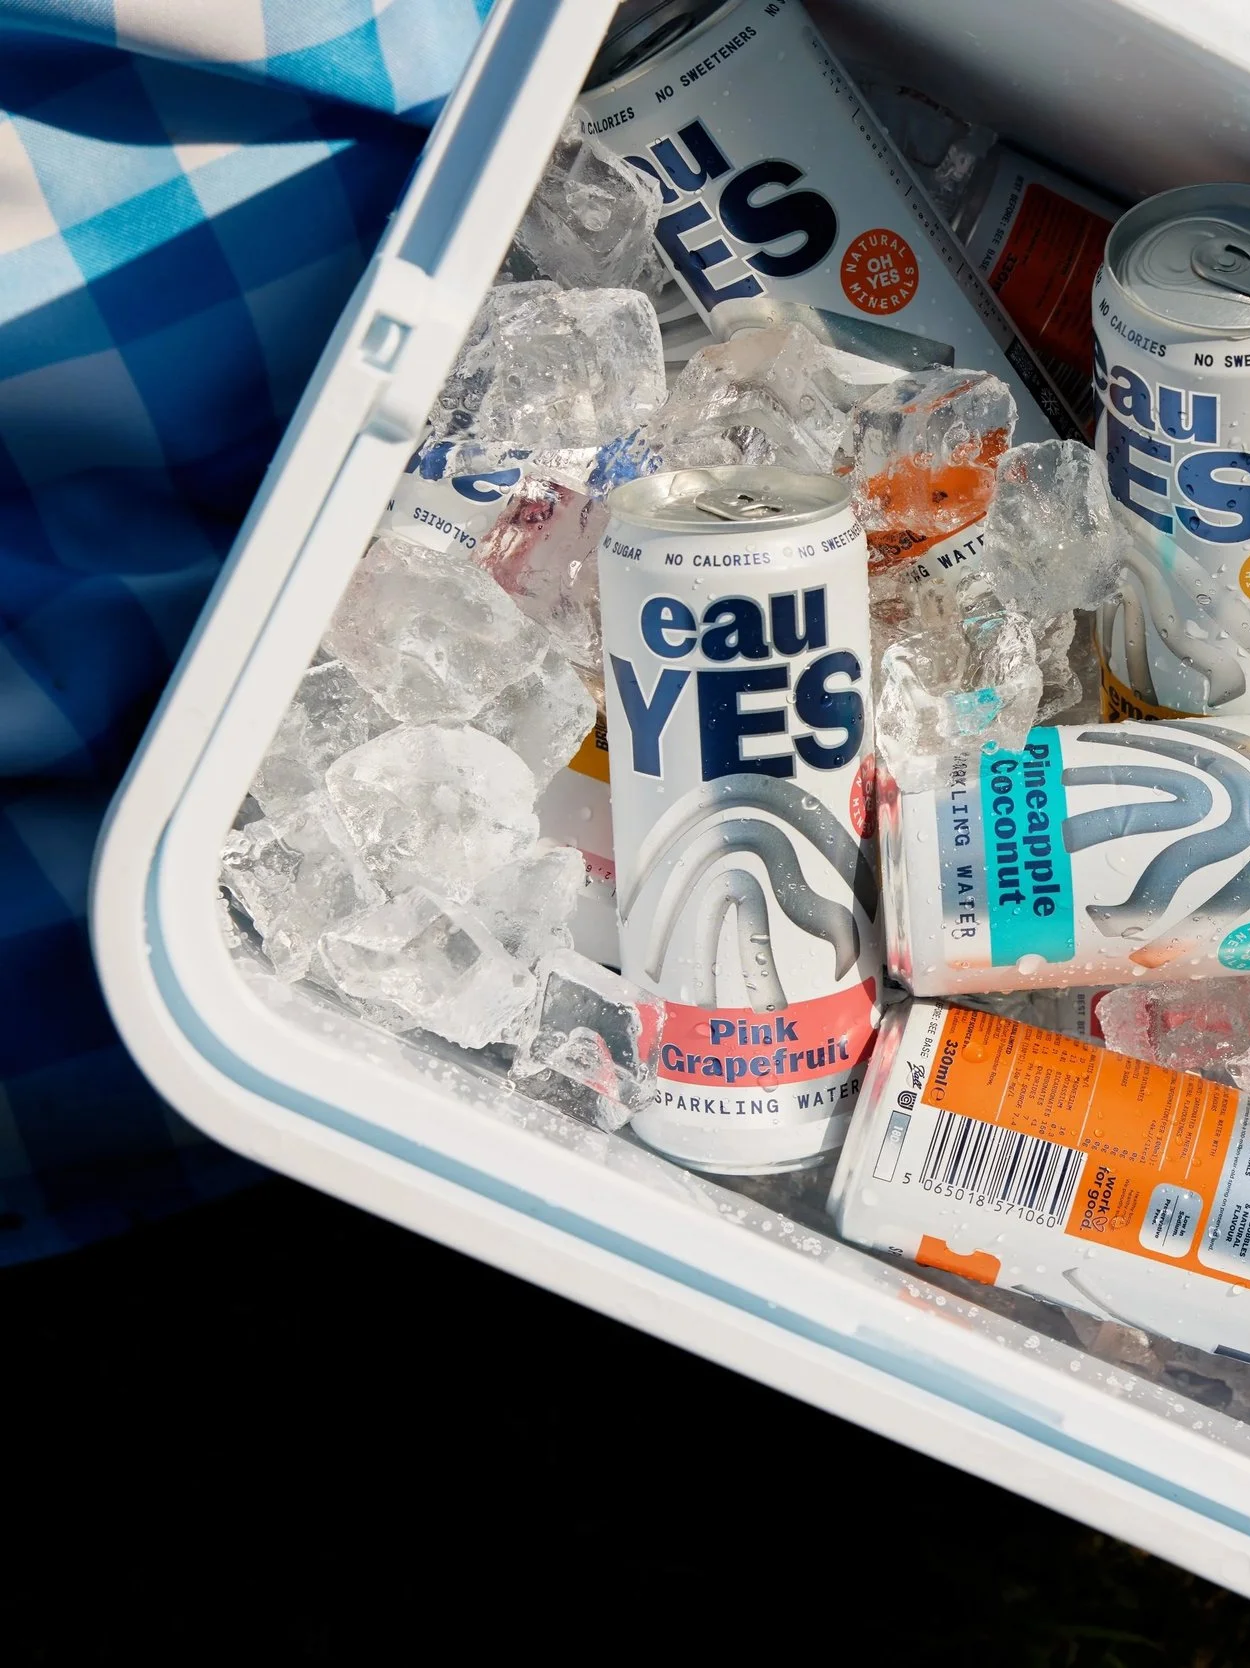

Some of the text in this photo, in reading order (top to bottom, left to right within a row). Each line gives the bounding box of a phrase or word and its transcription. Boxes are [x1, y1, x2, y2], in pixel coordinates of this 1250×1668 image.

[764, 4, 780, 17] NO
[655, 26, 757, 103] NO SWEETENERS
[654, 158, 838, 313] ES
[846, 234, 906, 272] NATURAL
[866, 268, 900, 290] YES
[867, 253, 893, 274] OH
[849, 267, 914, 309] MINERALS
[1099, 298, 1167, 358] NO CALORIES
[1194, 353, 1214, 368] NO
[413, 507, 477, 549] CALORIES
[602, 535, 642, 561] NO SUGAR
[665, 552, 771, 567] NO CALORIES
[797, 544, 816, 559] NO
[640, 584, 829, 662] eau
[609, 648, 865, 782] YES
[990, 759, 1026, 906] Coconut
[1022, 744, 1061, 918] Pineapple
[956, 865, 976, 939] WATER
[709, 1017, 799, 1046] Pink
[919, 1020, 938, 1058] SEE BASE
[661, 1037, 849, 1083] Grapefruit
[933, 1038, 959, 1086] 330ml
[985, 1070, 997, 1087] Row,
[1023, 1072, 1031, 1081] AT
[654, 1079, 860, 1114] SPARKLING WATER
[1006, 1081, 1017, 1098] mg/L
[1015, 1082, 1028, 1109] SOURCE
[1028, 1064, 1043, 1099] CHLORIDES
[1036, 1067, 1052, 1106] CARBONATES
[1043, 1070, 1061, 1117] BICARBONATES
[1056, 1073, 1071, 1108] POTASSIUM
[1065, 1075, 1080, 1111] MAGNESIUM
[891, 1125, 904, 1143] 18D
[1009, 1111, 1020, 1126] 7.4
[1179, 1096, 1201, 1160] CARBONATED MINERAL
[1208, 1118, 1223, 1157] WATER WITH
[901, 1172, 1058, 1229] 5 065018 571060
[1076, 1165, 1110, 1233] for good.
[1096, 1174, 1119, 1215] work
[1220, 1197, 1228, 1207] on
[1222, 1178, 1233, 1198] spring
[1150, 1207, 1161, 1226] Free.
[1153, 1197, 1171, 1239] Preservative
[1171, 1209, 1185, 1238] Sodium.
[1178, 1214, 1190, 1237] Low in
[1224, 1203, 1242, 1243] FLAVOUR
[1231, 1209, 1248, 1249] NATURAL
